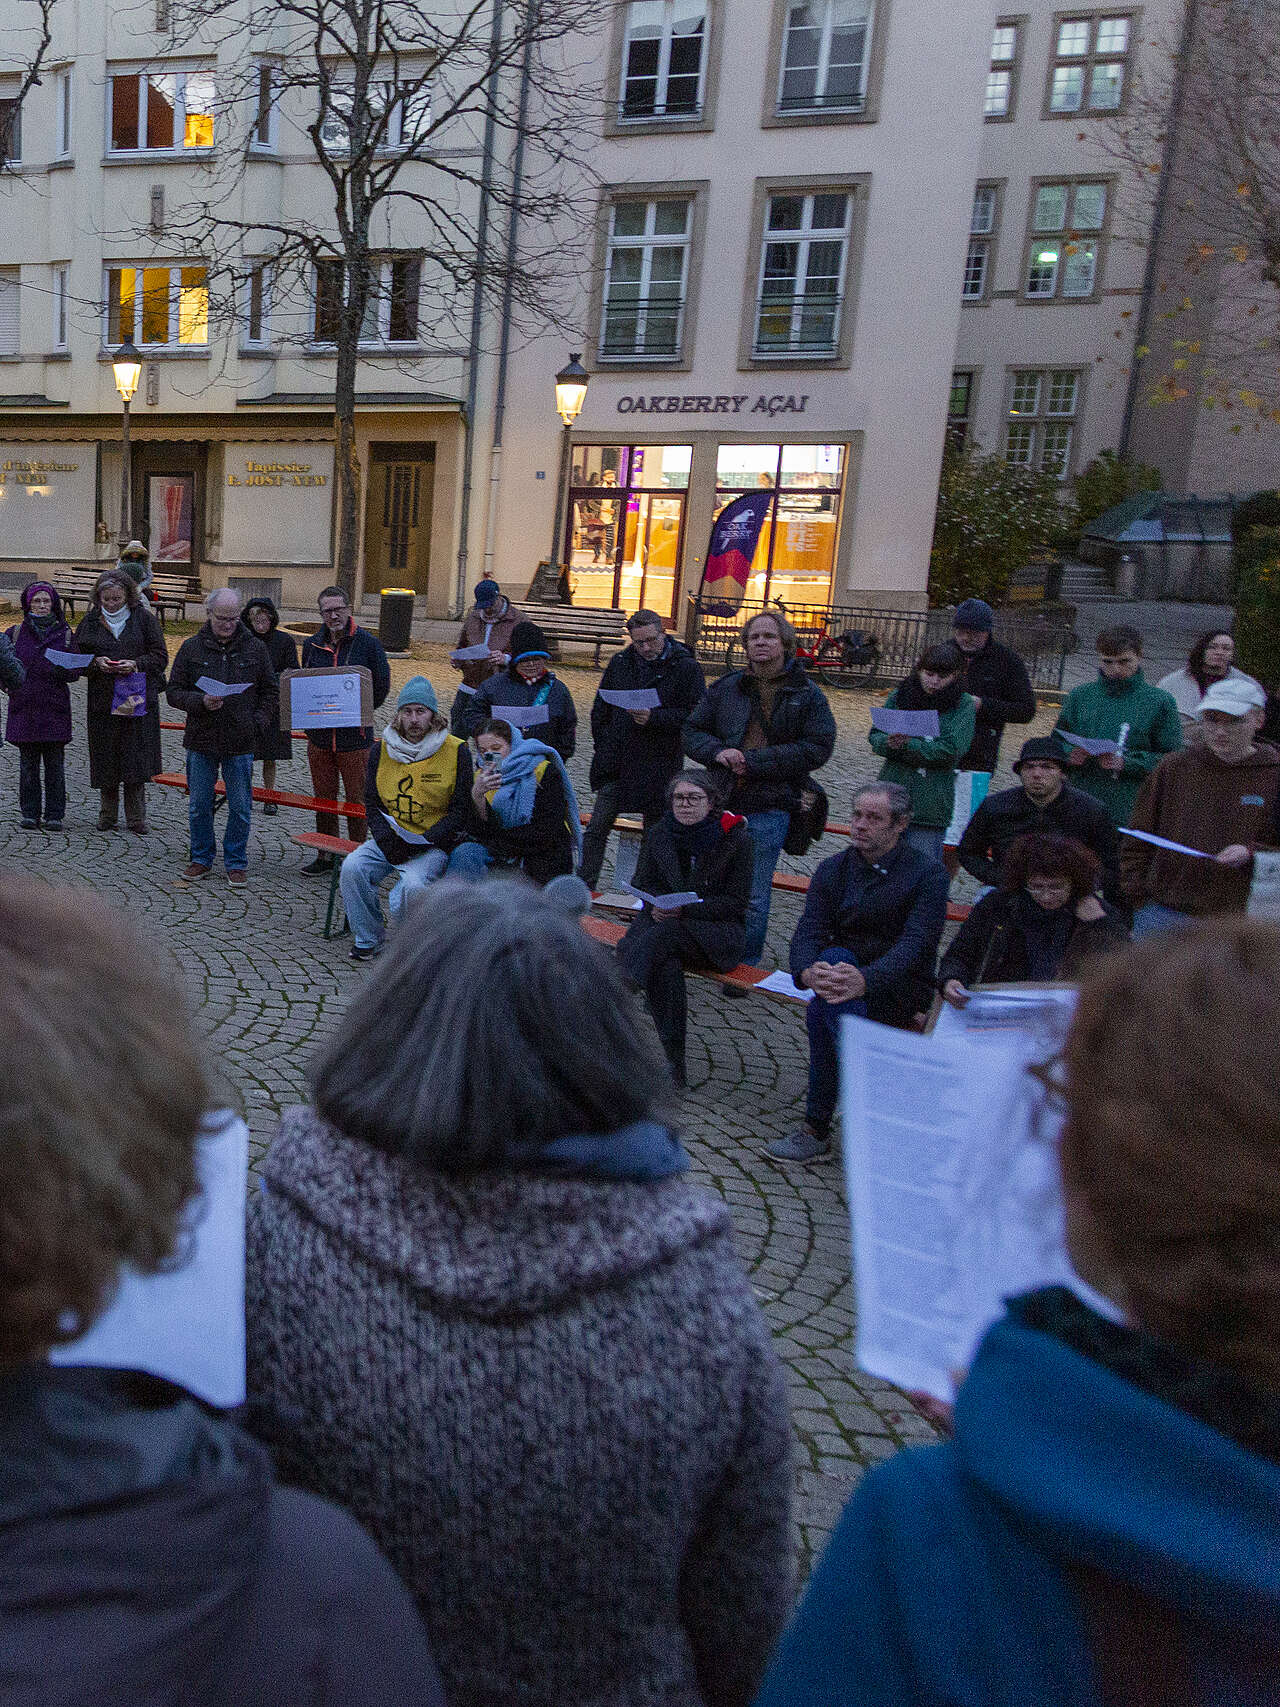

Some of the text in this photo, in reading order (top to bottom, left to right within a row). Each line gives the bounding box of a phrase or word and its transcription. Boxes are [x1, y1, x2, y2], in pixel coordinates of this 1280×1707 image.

[617, 395, 810, 418] OAKBERRY AÇAI
[247, 461, 313, 474] Tapissier
